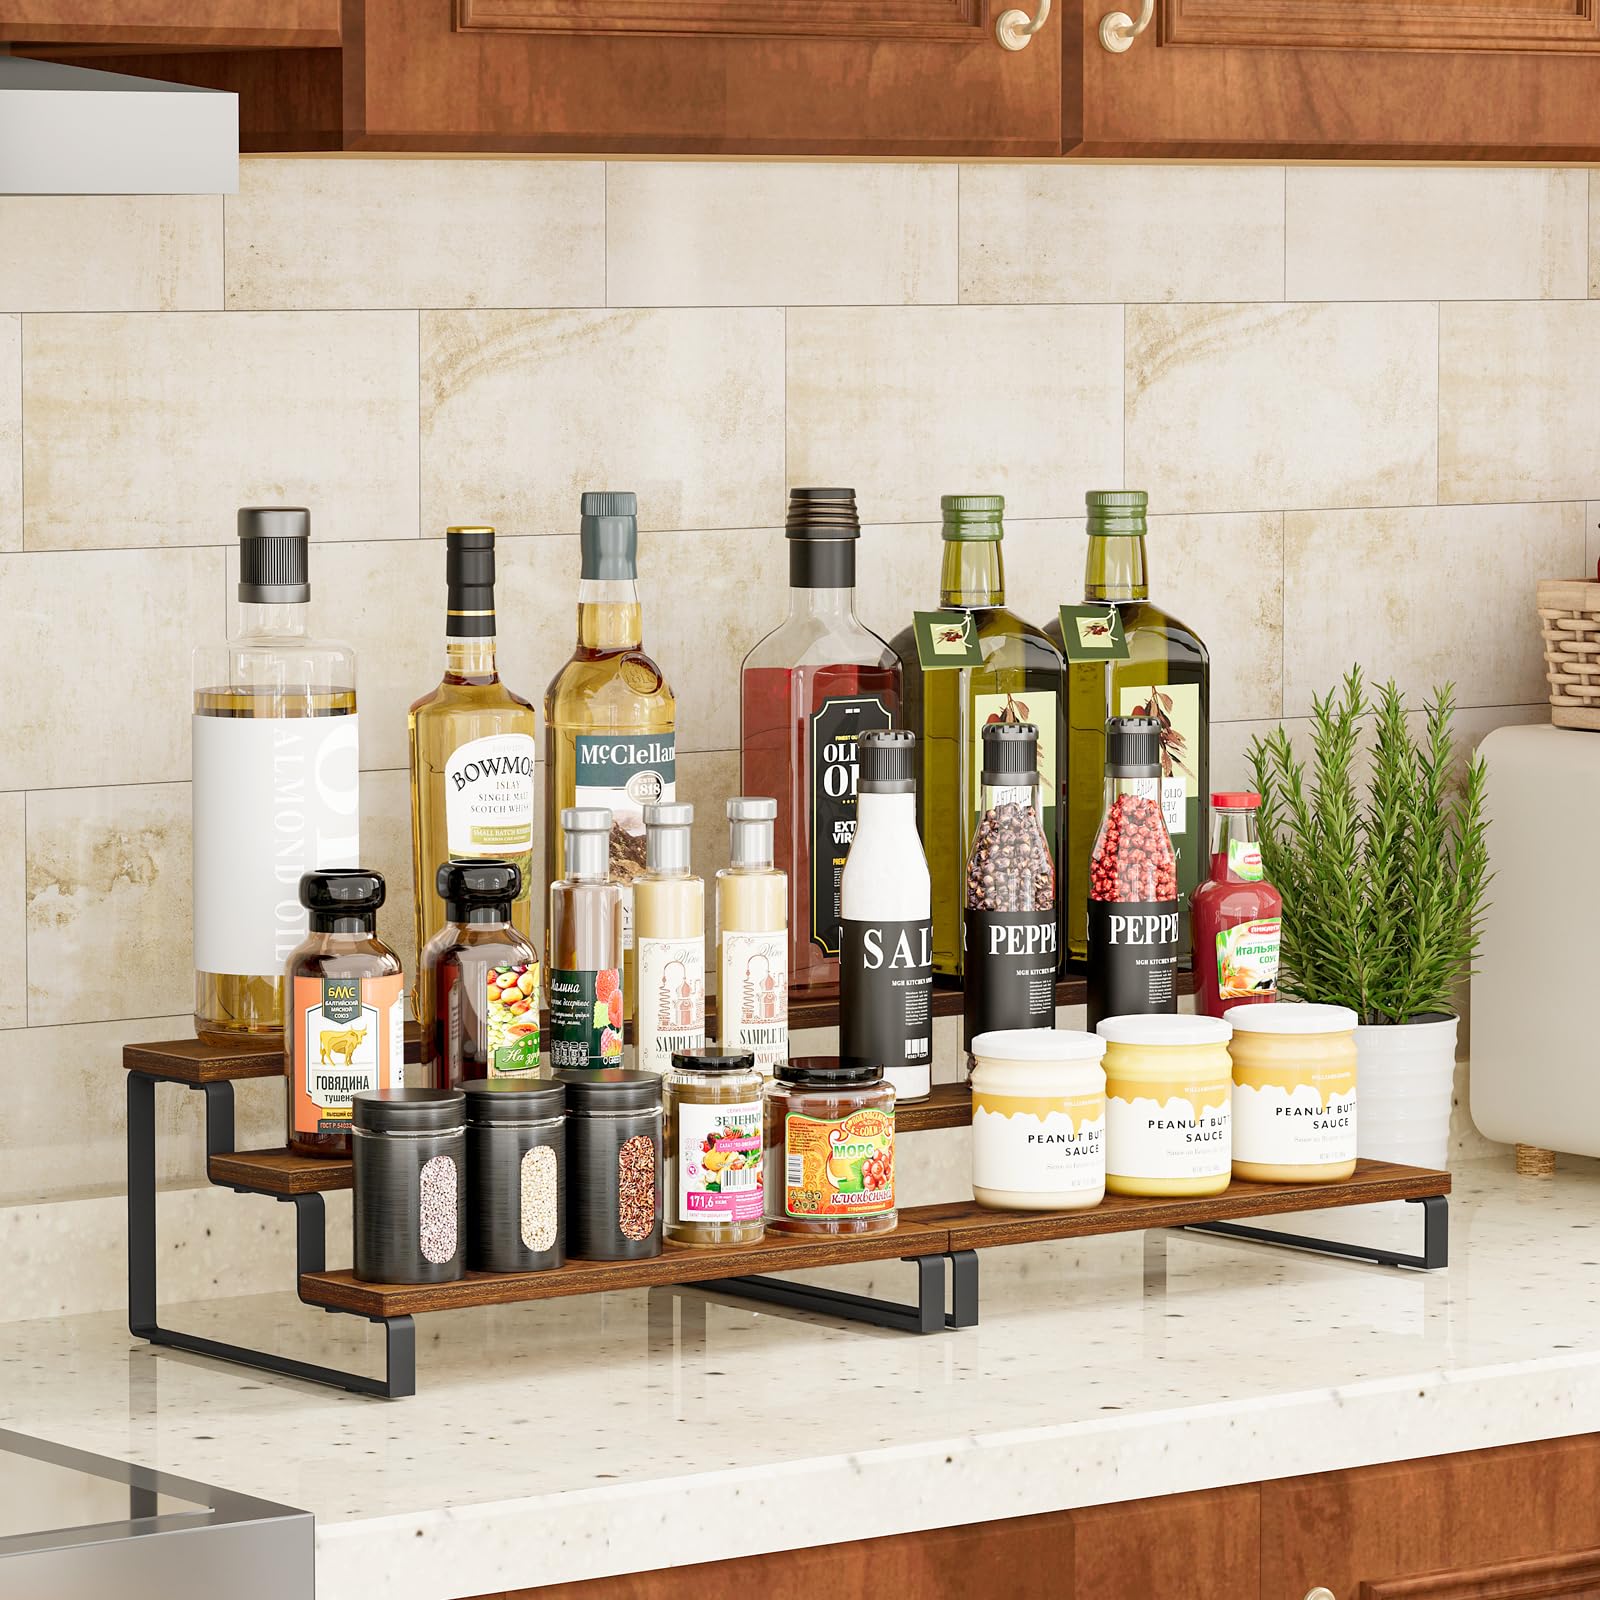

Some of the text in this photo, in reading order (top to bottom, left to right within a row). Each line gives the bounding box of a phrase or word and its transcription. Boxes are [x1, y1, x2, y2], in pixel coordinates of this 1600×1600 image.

[496, 780, 520, 790] ISLAY
[634, 783, 661, 796] 1818
[478, 794, 510, 802] SINGLE
[273, 727, 305, 885] ALMOND
[470, 804, 506, 814] SCOTCH
[864, 927, 933, 969] SAL
[328, 985, 356, 998] БМС
[316, 1075, 370, 1093] ГОВЯДИНА
[1276, 1106, 1332, 1116] PEANUT
[1148, 1119, 1204, 1130] PEANUT
[1313, 1118, 1348, 1130] SAUCE
[1028, 1132, 1083, 1144] PEANUT
[1186, 1130, 1222, 1142] SAUCE
[833, 1144, 874, 1158] МОРС
[1065, 1144, 1099, 1156] SAUCE
[690, 1195, 714, 1208] 171,6
